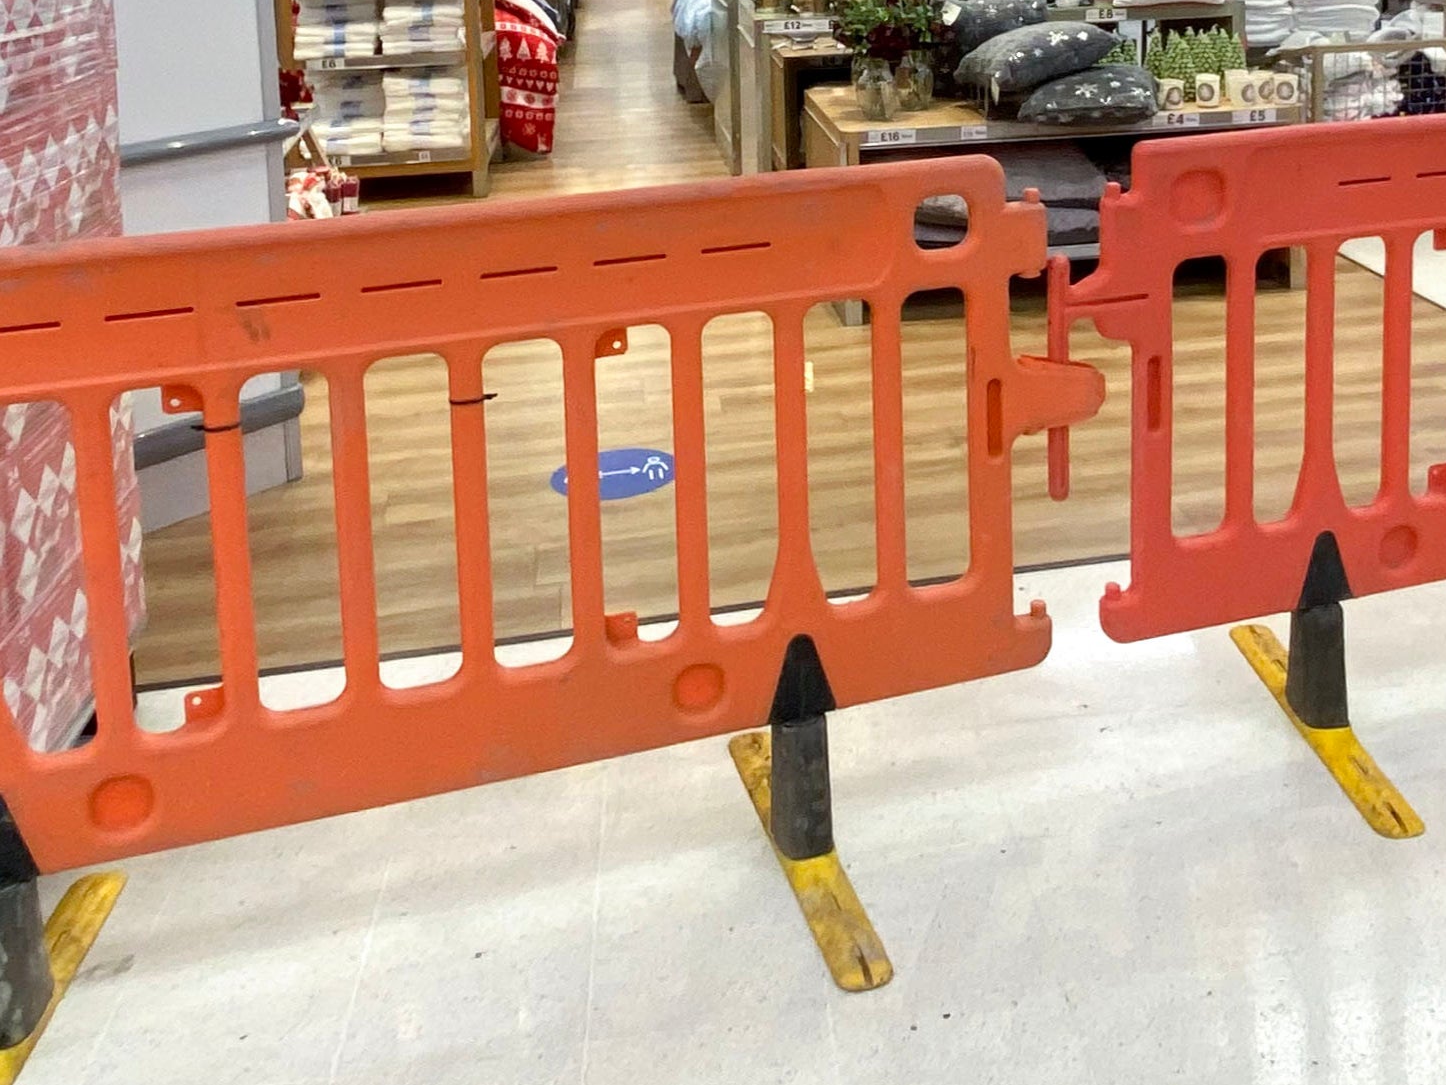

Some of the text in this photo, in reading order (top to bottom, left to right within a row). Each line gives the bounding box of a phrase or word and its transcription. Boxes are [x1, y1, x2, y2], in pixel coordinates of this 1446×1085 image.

[784, 21, 801, 30] £12
[1167, 113, 1184, 125] £4
[1249, 110, 1266, 122] £5
